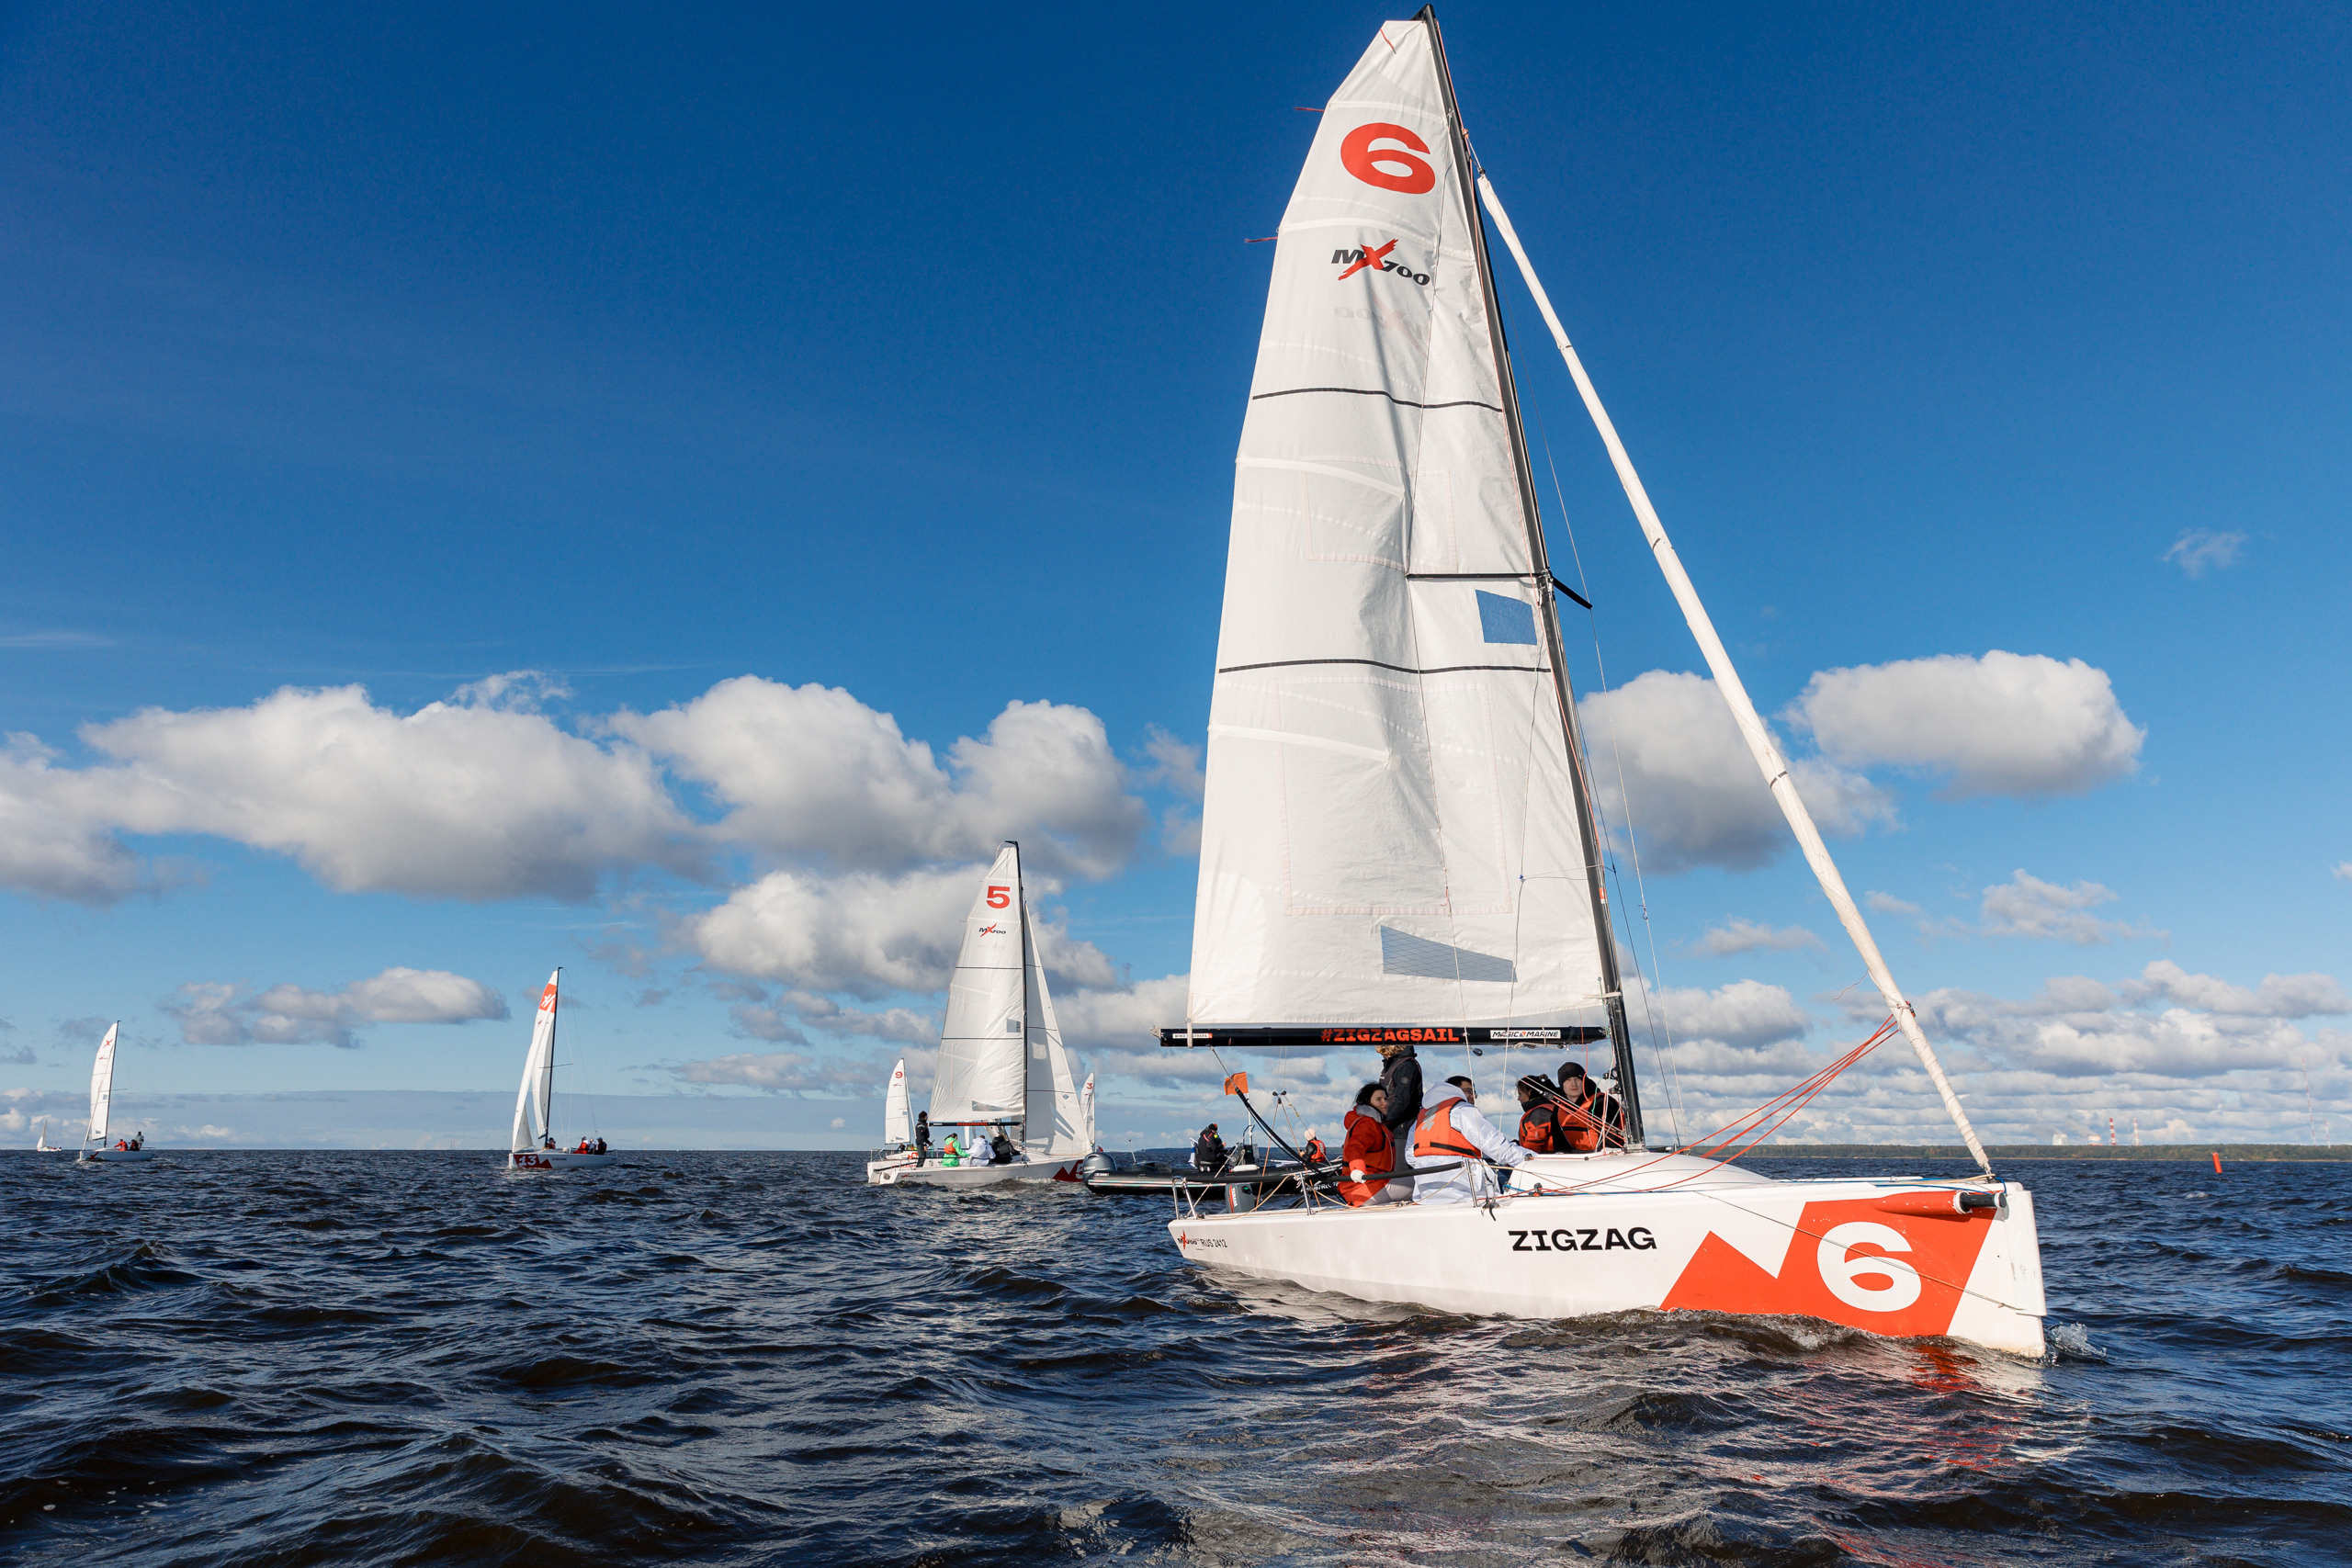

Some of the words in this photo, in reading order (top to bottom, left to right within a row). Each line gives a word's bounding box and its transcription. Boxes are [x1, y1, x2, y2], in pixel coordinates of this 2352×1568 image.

[1340, 122, 1435, 194] 6
[986, 886, 1011, 909] 5
[1320, 1028, 1460, 1042] #ZIGZAGSAIL
[895, 1071, 903, 1079] 9
[518, 1156, 537, 1167] 13
[1200, 1238, 1214, 1247] RUS
[1508, 1226, 1657, 1251] ZIGZAG
[1816, 1221, 1922, 1313] 6
